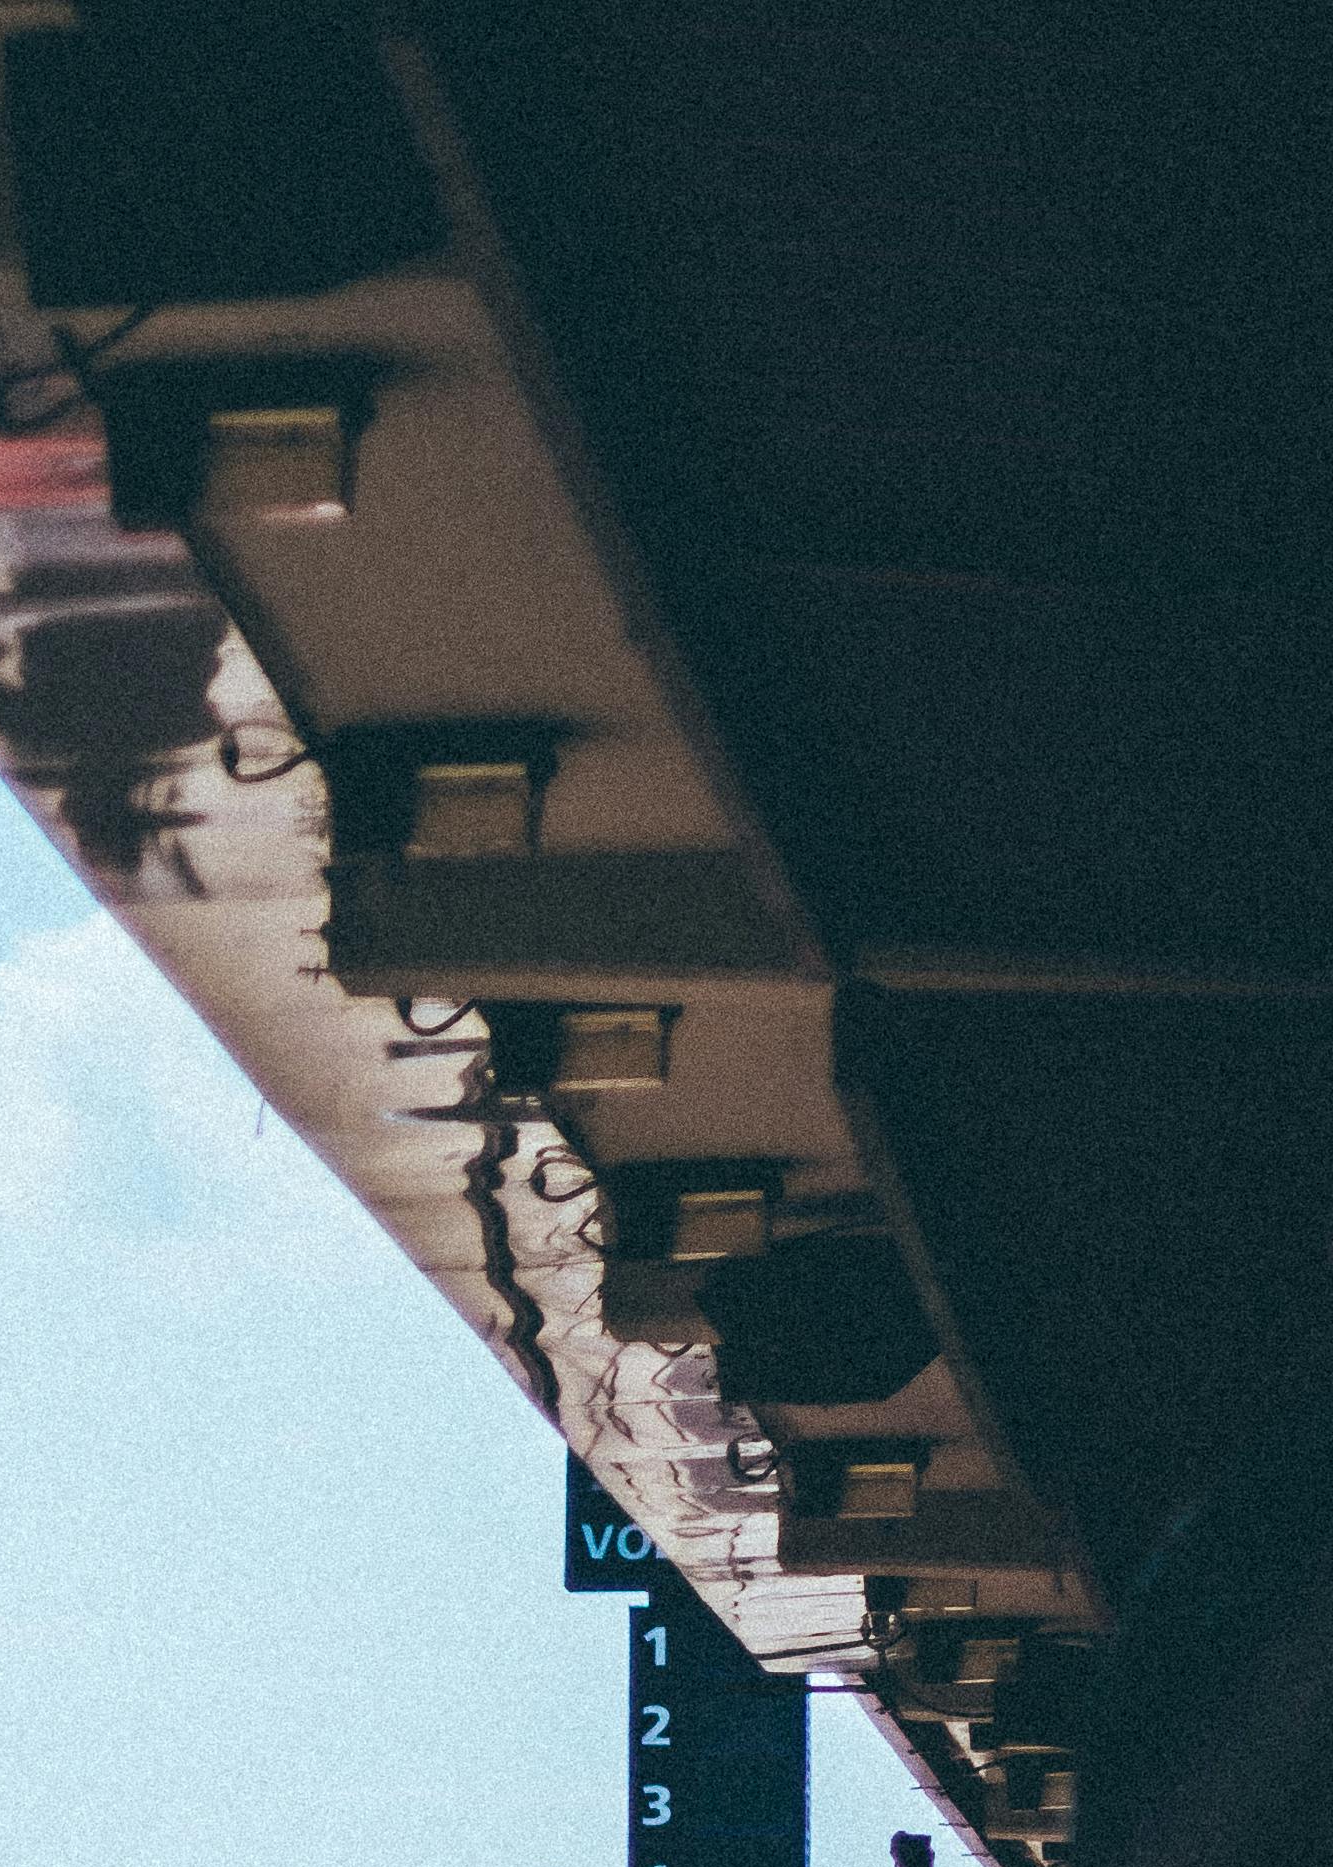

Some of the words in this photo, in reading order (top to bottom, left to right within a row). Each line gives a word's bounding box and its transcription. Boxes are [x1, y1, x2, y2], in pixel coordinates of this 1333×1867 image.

[581, 1523, 668, 1560] VO
[643, 1626, 667, 1666] 1
[641, 1705, 671, 1746] 2
[642, 1784, 672, 1826] 3
